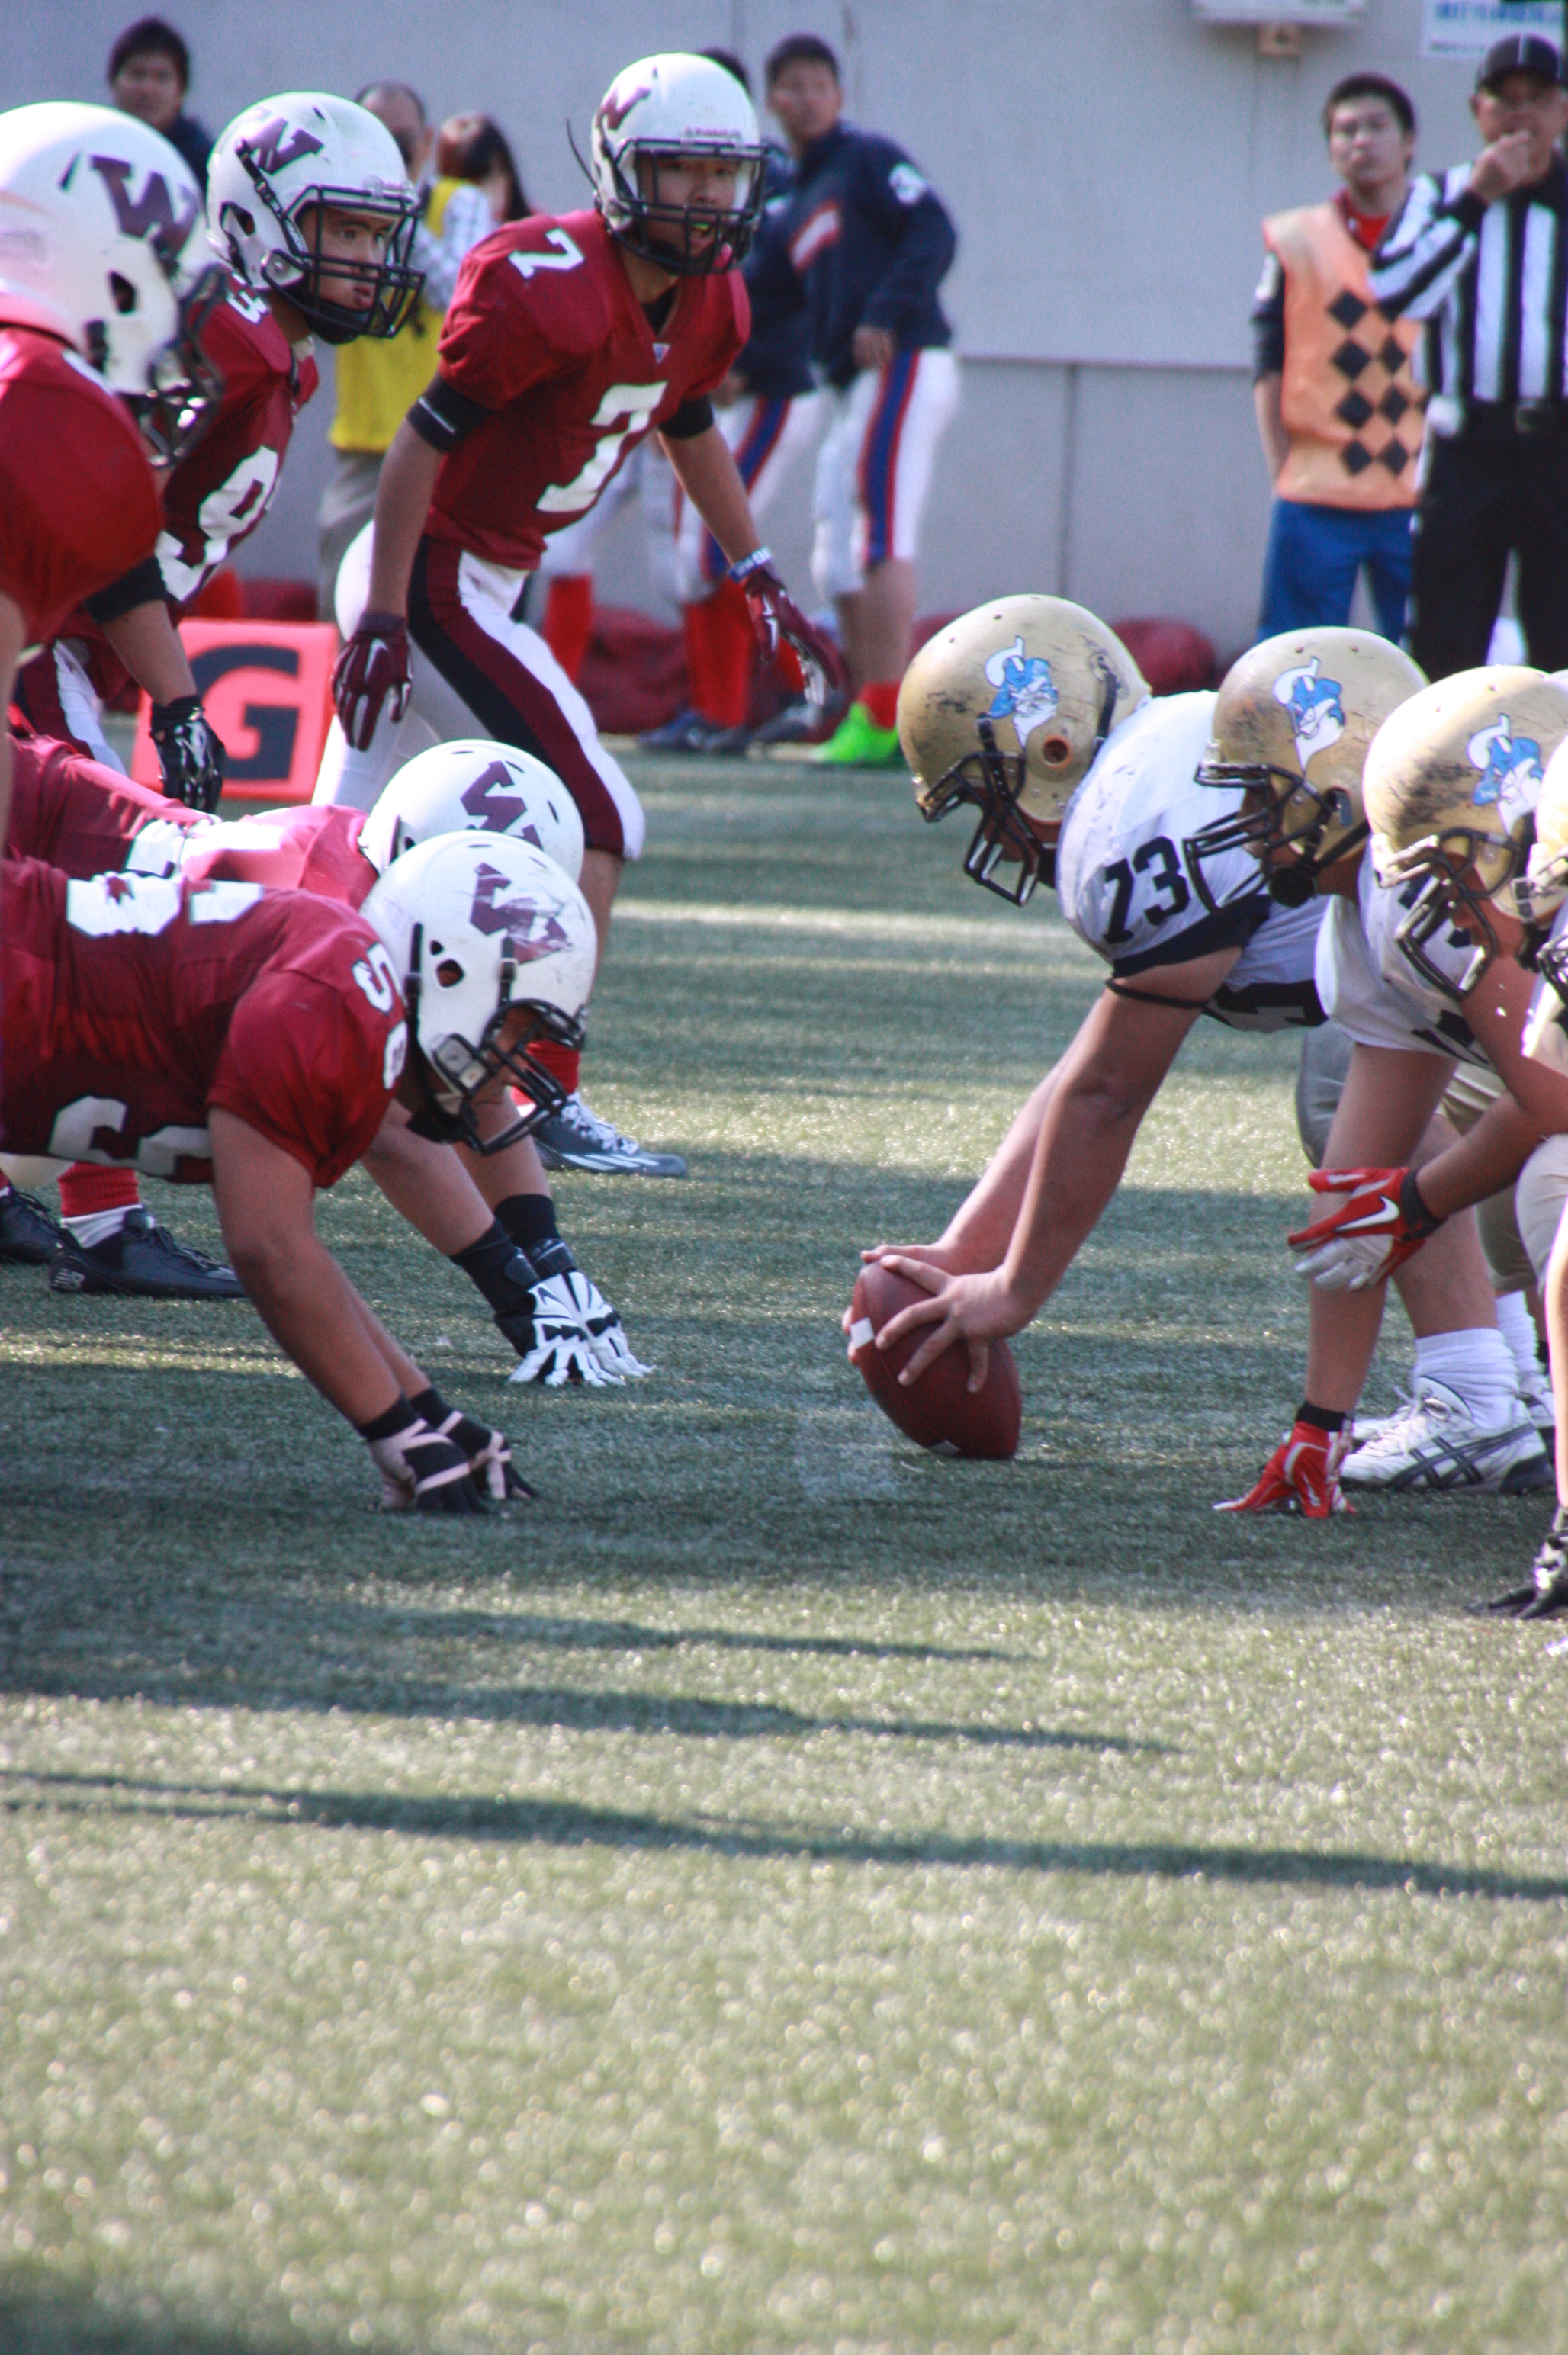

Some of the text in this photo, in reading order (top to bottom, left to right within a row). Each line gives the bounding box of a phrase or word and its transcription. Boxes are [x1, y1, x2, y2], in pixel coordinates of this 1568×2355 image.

[88, 153, 200, 263] W
[508, 228, 585, 280] 7
[536, 381, 669, 513] 7
[189, 644, 300, 780] G
